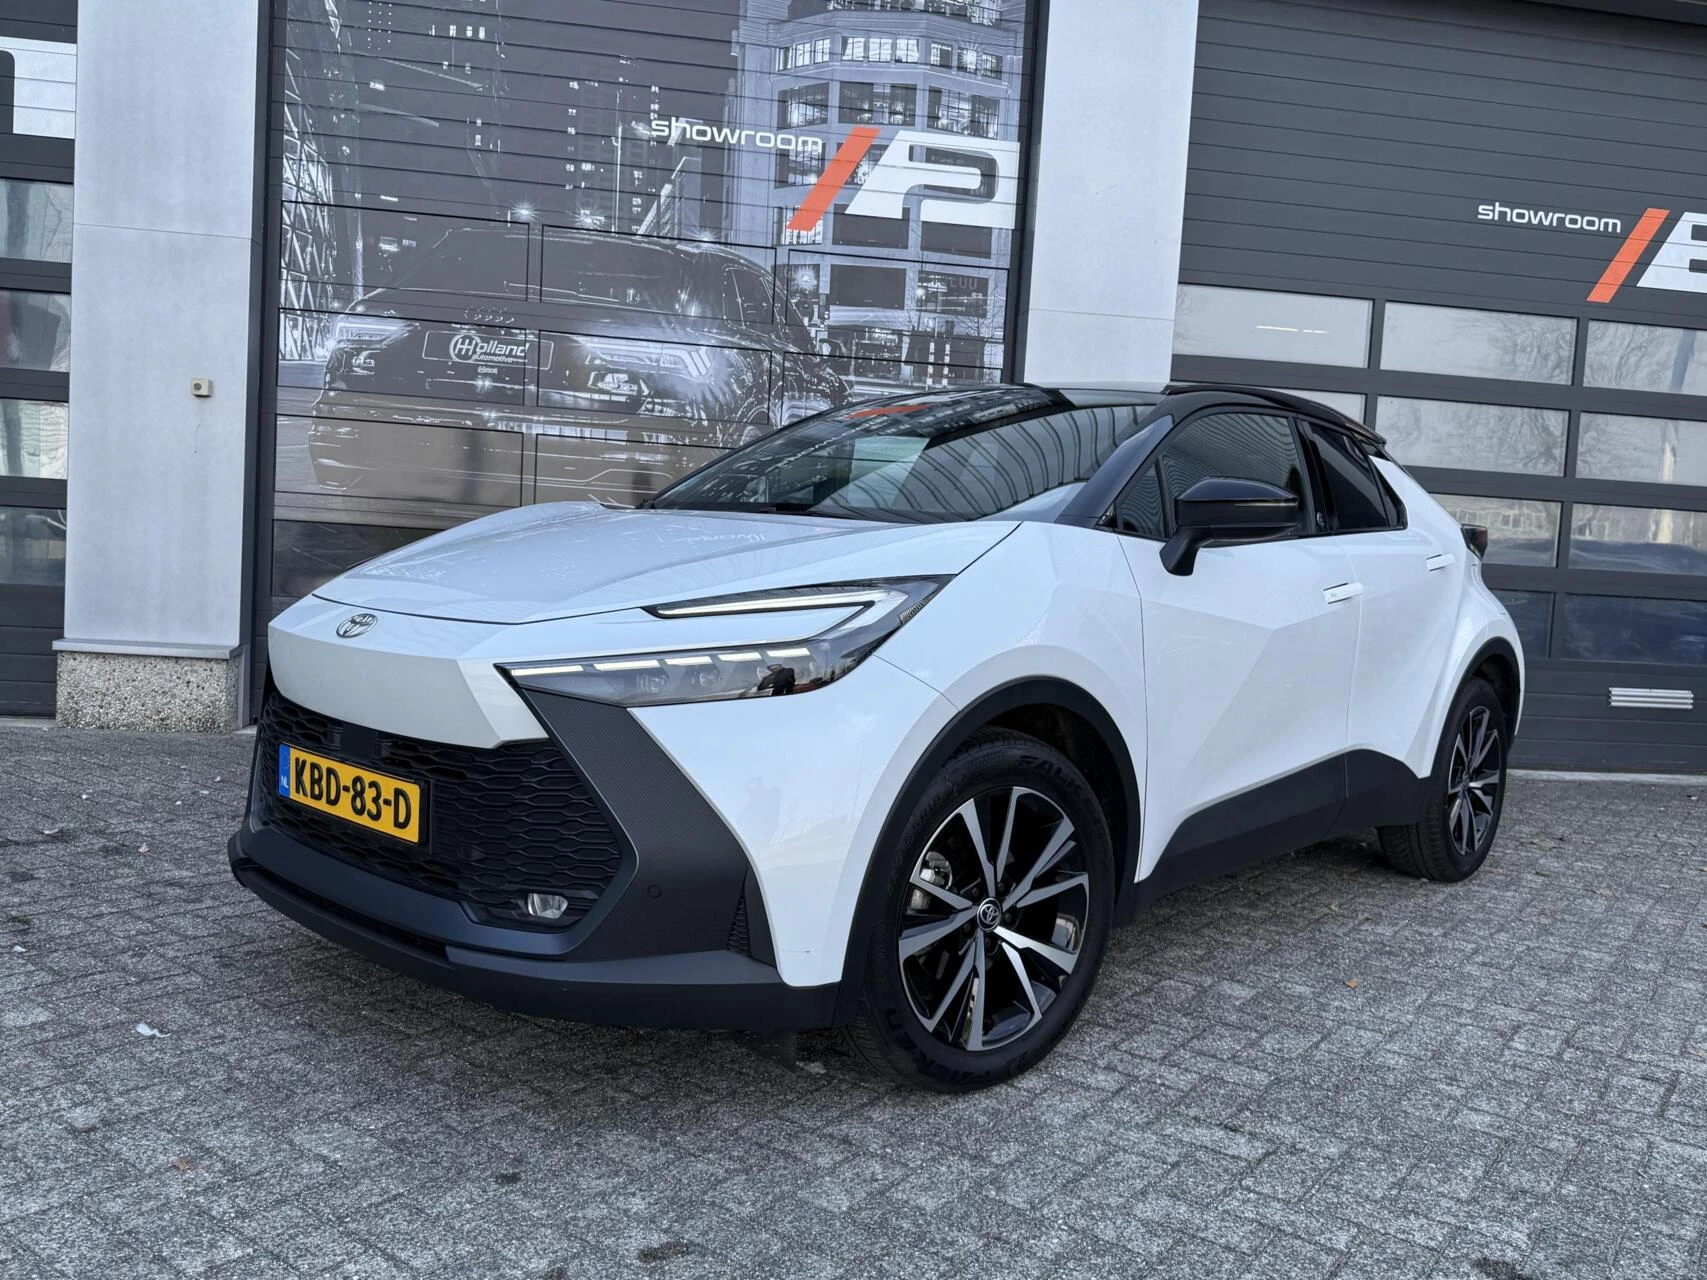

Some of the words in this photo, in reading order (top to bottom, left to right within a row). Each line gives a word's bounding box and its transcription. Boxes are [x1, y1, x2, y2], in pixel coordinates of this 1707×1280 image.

[651, 117, 823, 153] showroom
[1478, 202, 1621, 233] showroom
[281, 776, 289, 789] NL
[294, 757, 411, 830] KBD-83-D
